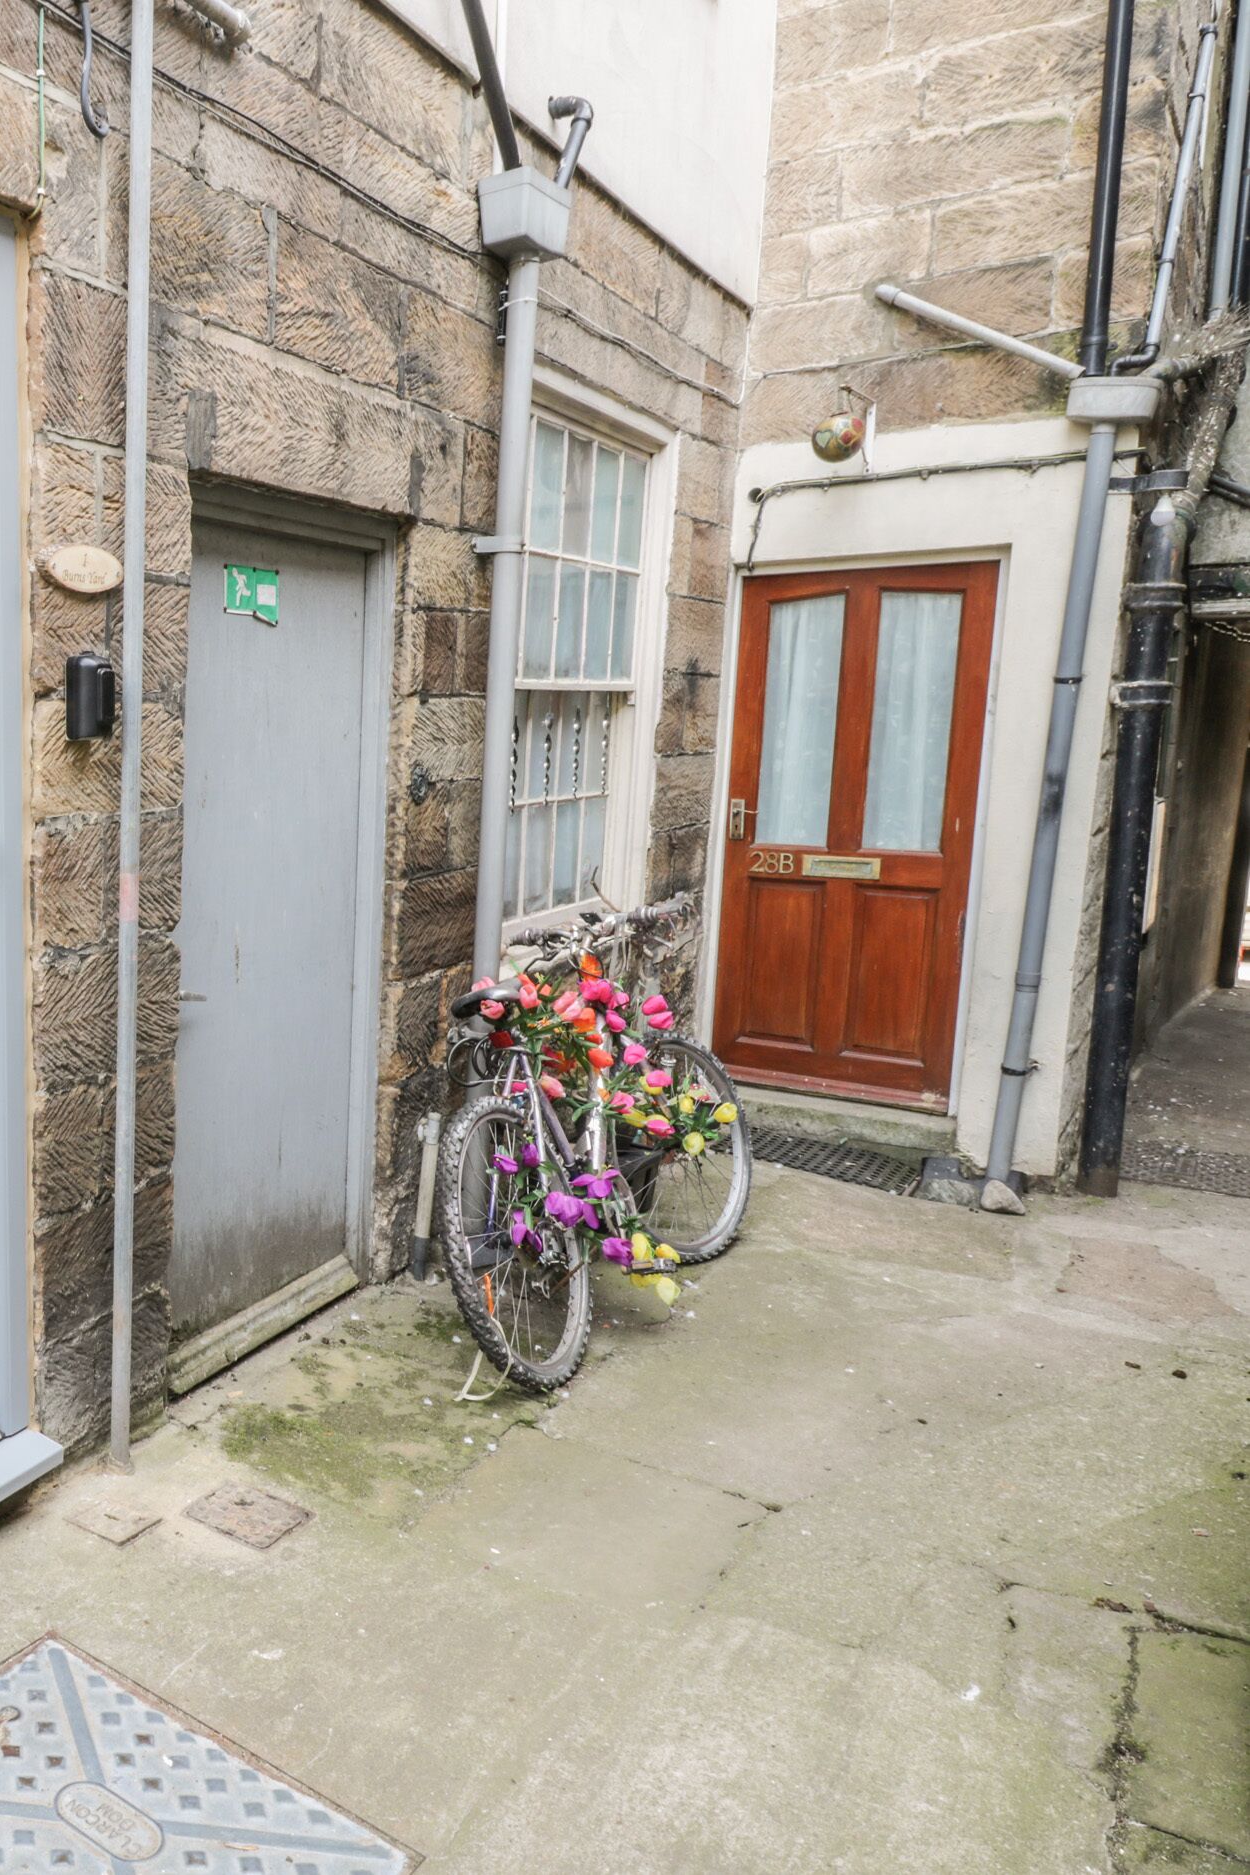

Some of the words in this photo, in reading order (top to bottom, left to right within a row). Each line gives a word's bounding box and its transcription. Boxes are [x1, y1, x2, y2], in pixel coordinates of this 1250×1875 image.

[62, 568, 86, 583] Burns
[89, 571, 108, 585] Yard
[749, 850, 794, 874] 28B
[65, 1799, 142, 1856] CLARCON
